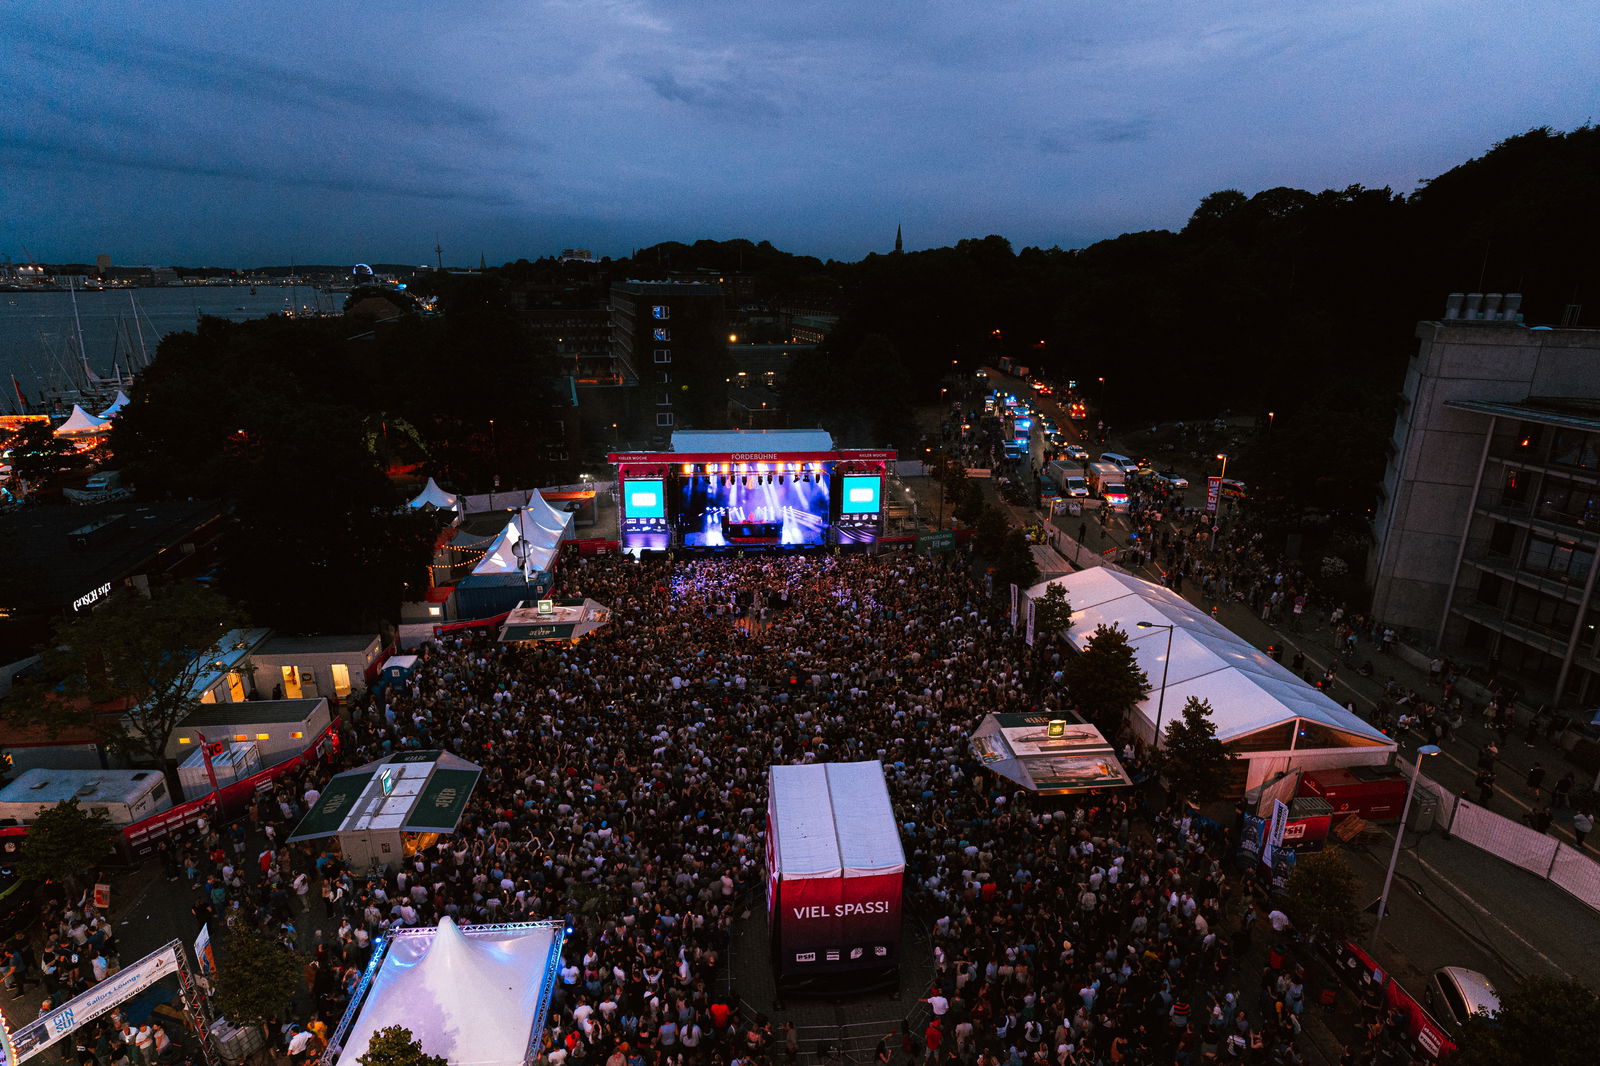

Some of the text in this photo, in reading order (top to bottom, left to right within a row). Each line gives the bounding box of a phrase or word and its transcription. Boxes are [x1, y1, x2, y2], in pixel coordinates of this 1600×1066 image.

[731, 452, 778, 460] FÖRDEBÜHNE
[1206, 479, 1220, 511] REWE
[73, 589, 99, 612] GOSCH
[793, 901, 889, 919] VIEL SPASS!
[113, 973, 141, 991] Lounge
[53, 1008, 74, 1027] GIN
[56, 1017, 79, 1034] SUL
